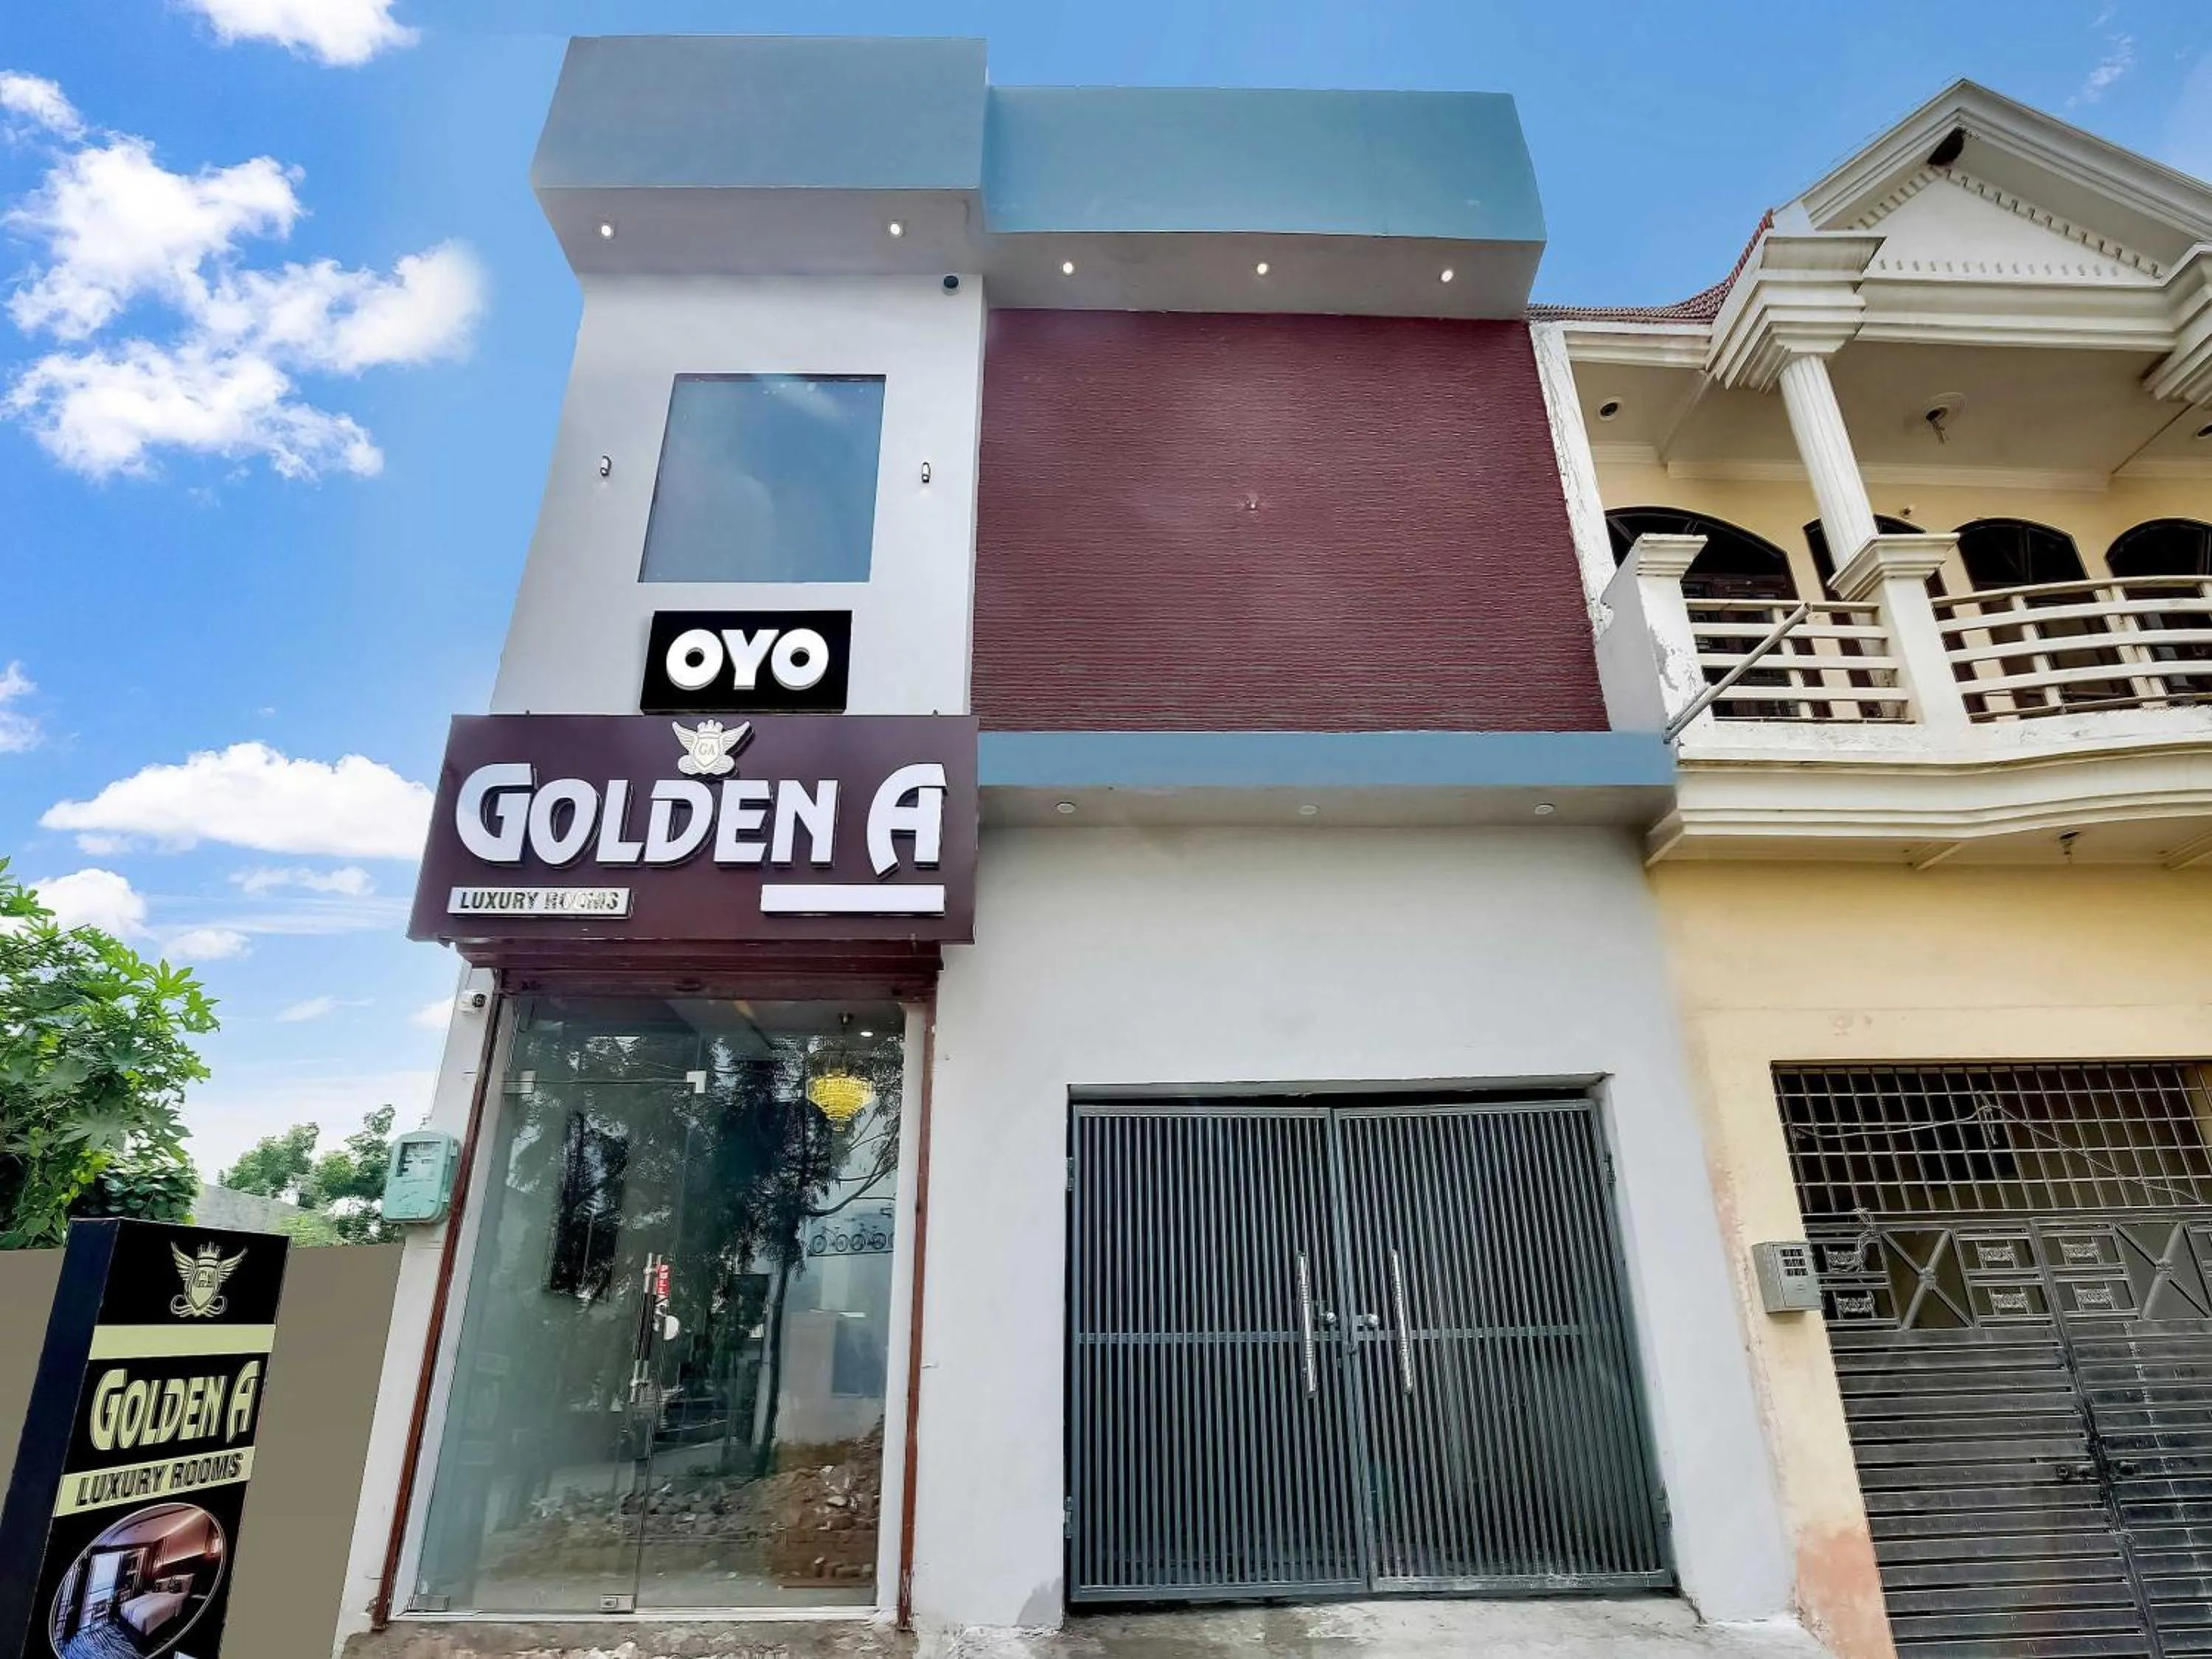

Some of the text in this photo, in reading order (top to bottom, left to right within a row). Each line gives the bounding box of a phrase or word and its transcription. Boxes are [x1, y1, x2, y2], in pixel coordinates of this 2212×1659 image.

[666, 628, 829, 691] OYO
[455, 762, 947, 876] GOLDEN A
[459, 891, 538, 909] LUXURY
[90, 1360, 260, 1450] GOLDEN A
[76, 1452, 244, 1506] LUXURY ROOMS
